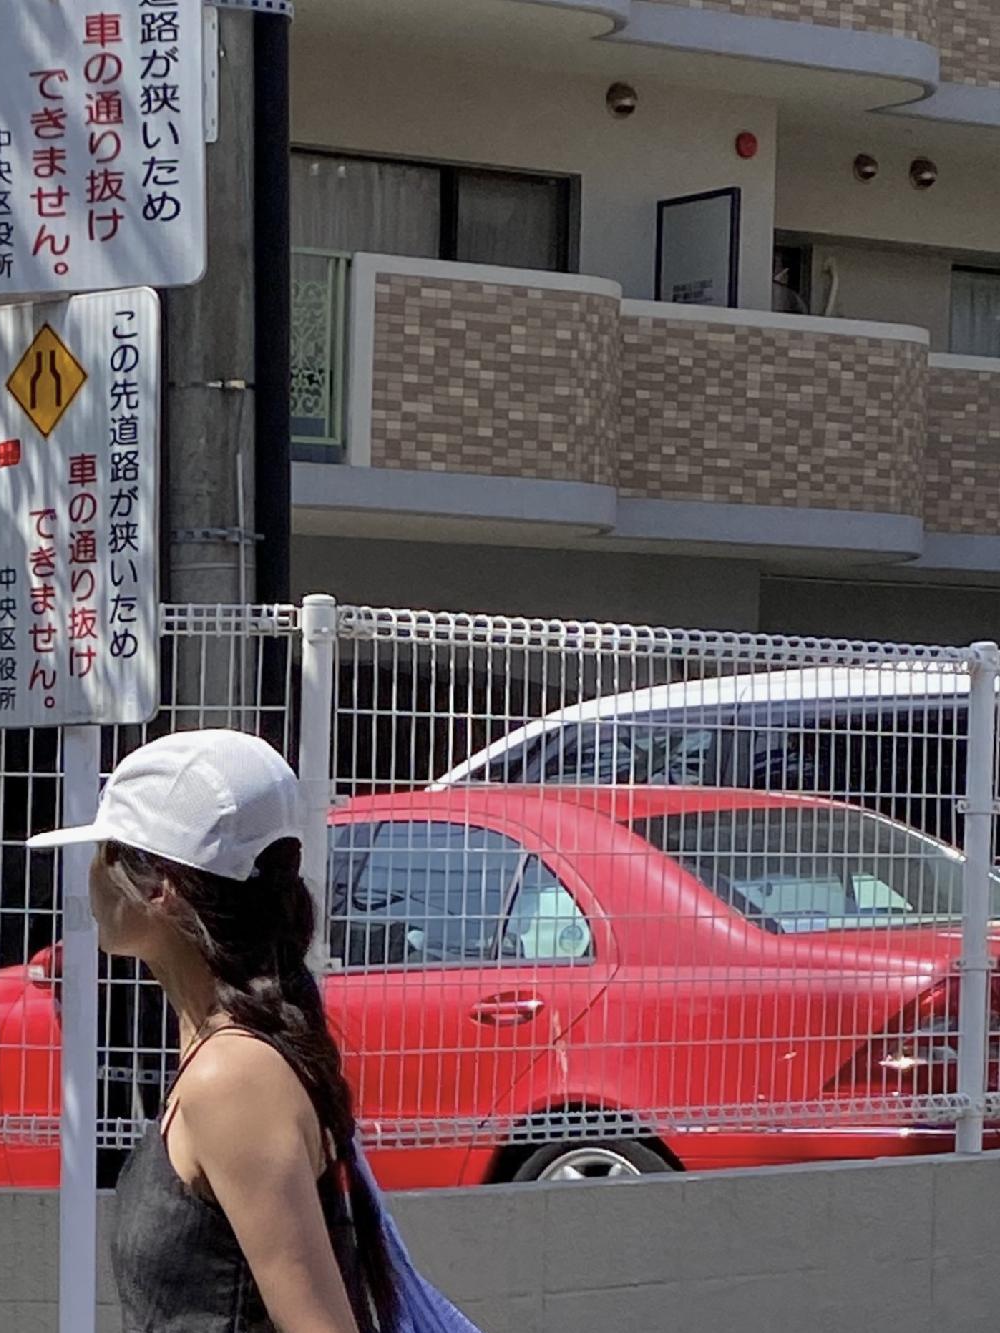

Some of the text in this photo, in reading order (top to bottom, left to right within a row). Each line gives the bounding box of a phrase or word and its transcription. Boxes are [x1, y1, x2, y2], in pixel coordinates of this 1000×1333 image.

[29, 69, 70, 276] できません。
[83, 13, 126, 242] 車の通り抜け
[68, 453, 97, 678] 車の通り抜け
[109, 310, 139, 659] この先道路が狭いため
[28, 509, 57, 709] できません。
